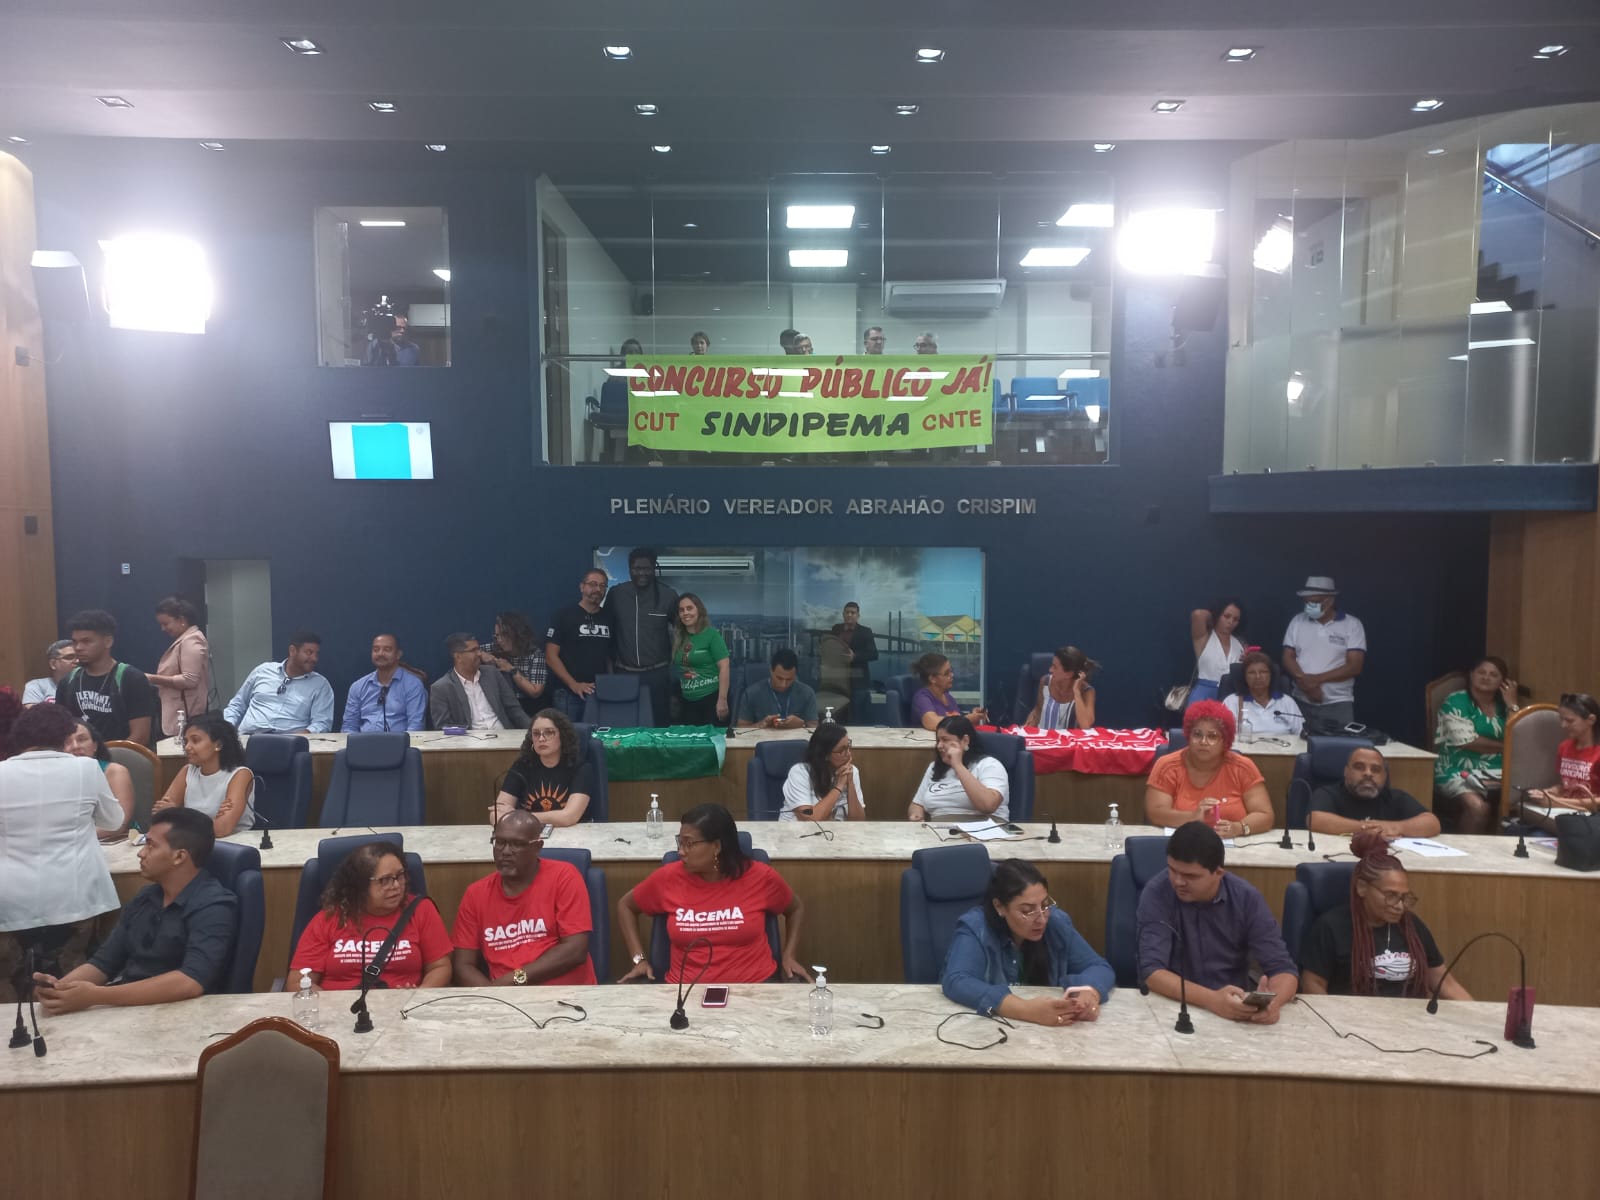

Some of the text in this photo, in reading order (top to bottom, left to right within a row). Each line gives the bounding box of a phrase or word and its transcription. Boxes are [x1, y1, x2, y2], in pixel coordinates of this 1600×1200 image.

[629, 355, 993, 399] CONCURSO PÚBLICO JÁ!
[634, 409, 982, 437] CUT SINDIPEMA CNTE
[610, 493, 1037, 515] PLENÁRIO VEREADOR ABRAHÃO CRISPIM
[676, 906, 744, 923] SACEMA
